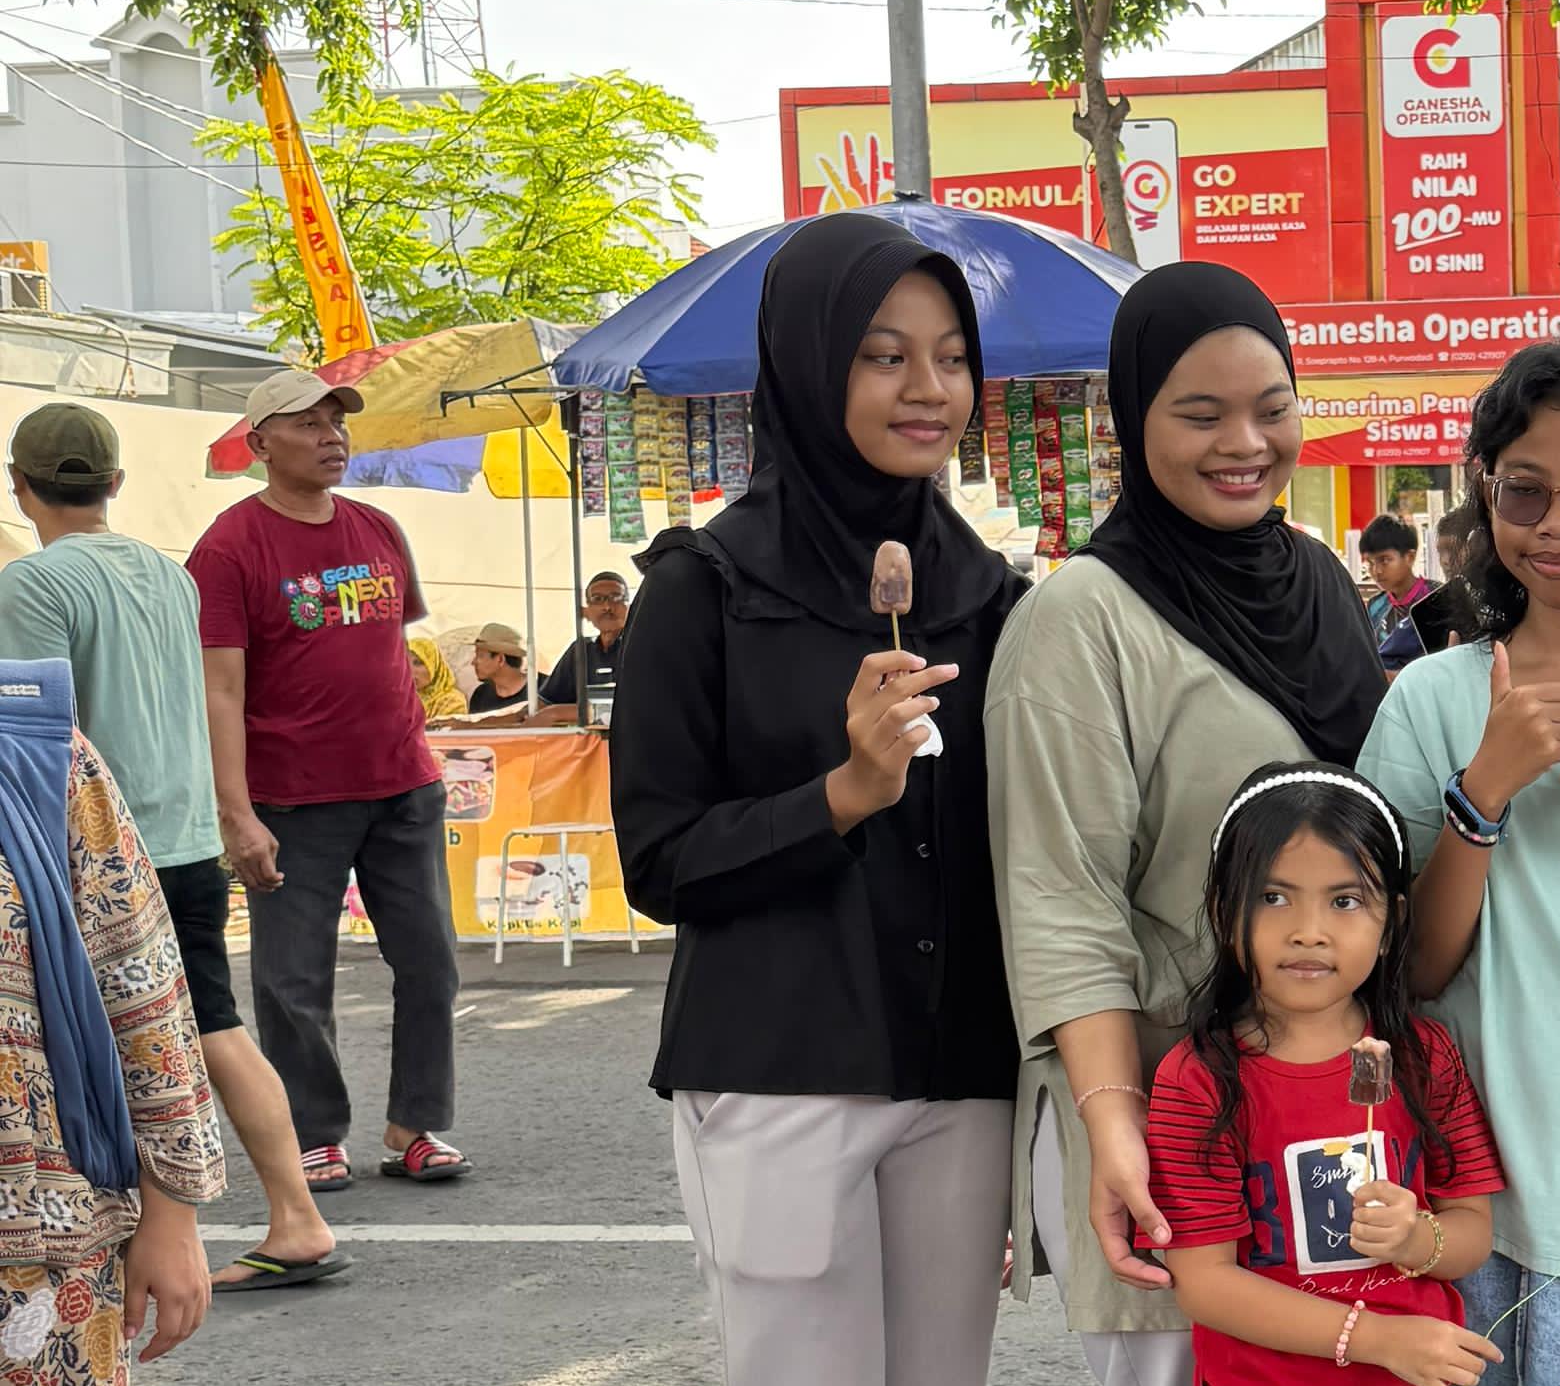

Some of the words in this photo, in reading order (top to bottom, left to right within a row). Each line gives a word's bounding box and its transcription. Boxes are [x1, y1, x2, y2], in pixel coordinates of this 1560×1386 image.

[1403, 96, 1483, 111] GANESHA
[1396, 110, 1491, 125] OPERATION
[1420, 152, 1467, 171] RAIH
[1192, 165, 1236, 188] GO
[1412, 175, 1478, 198] NILAI
[944, 184, 1093, 210] FORMULA
[1194, 193, 1304, 218] EXPERT
[1408, 255, 1432, 273] DI
[1436, 253, 1484, 272] SINI!
[1283, 313, 1415, 346] Ganesha
[1298, 392, 1416, 417] Menerima
[1365, 420, 1437, 442] Siswa
[322, 564, 371, 585] GEAR
[336, 576, 395, 603] NEXT
[324, 598, 401, 626] PHASE
